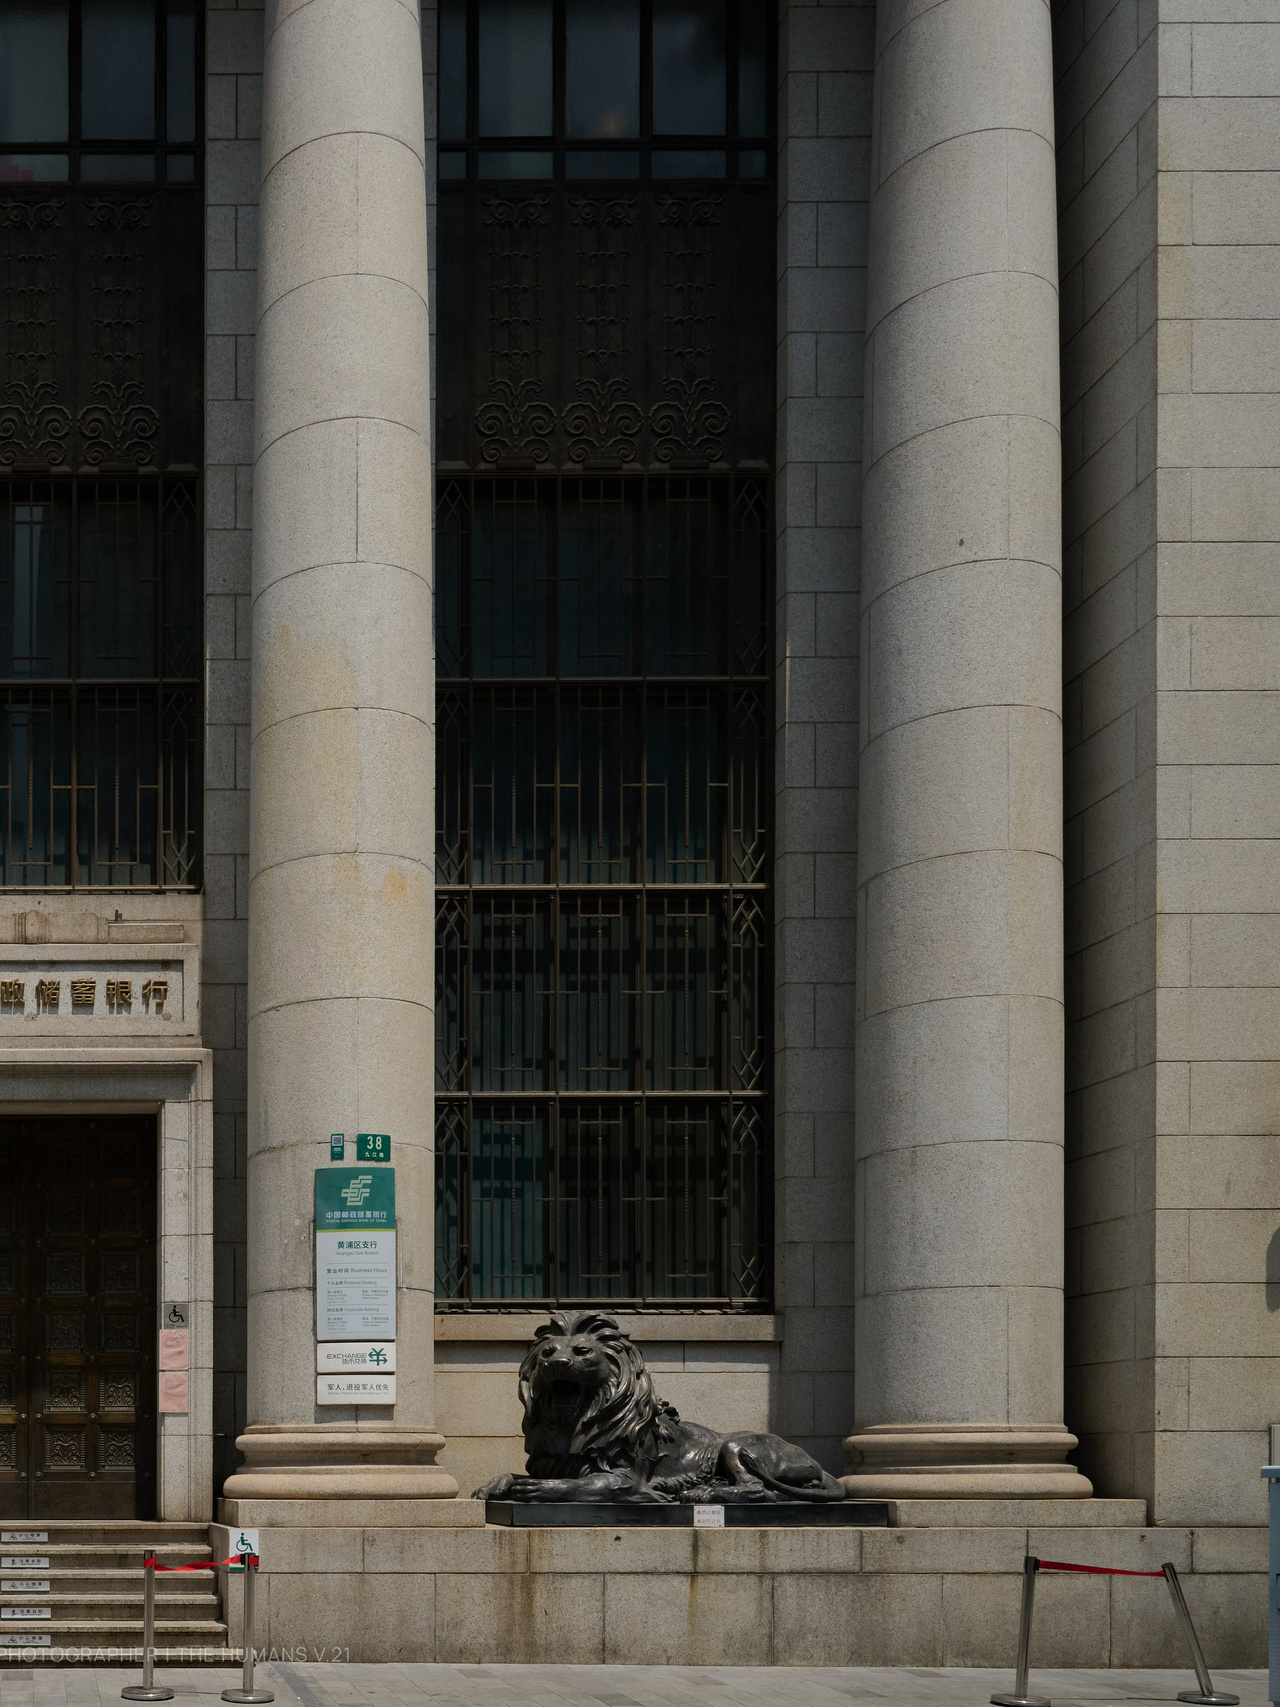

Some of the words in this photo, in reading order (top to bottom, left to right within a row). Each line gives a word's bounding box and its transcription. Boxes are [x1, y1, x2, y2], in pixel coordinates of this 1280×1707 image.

[366, 1135, 382, 1150] 38
[325, 1210, 387, 1219] 中国邮政储蓄银行
[337, 1240, 378, 1249] 黄浦区支行
[326, 1383, 389, 1391] 军人、退役军人优先
